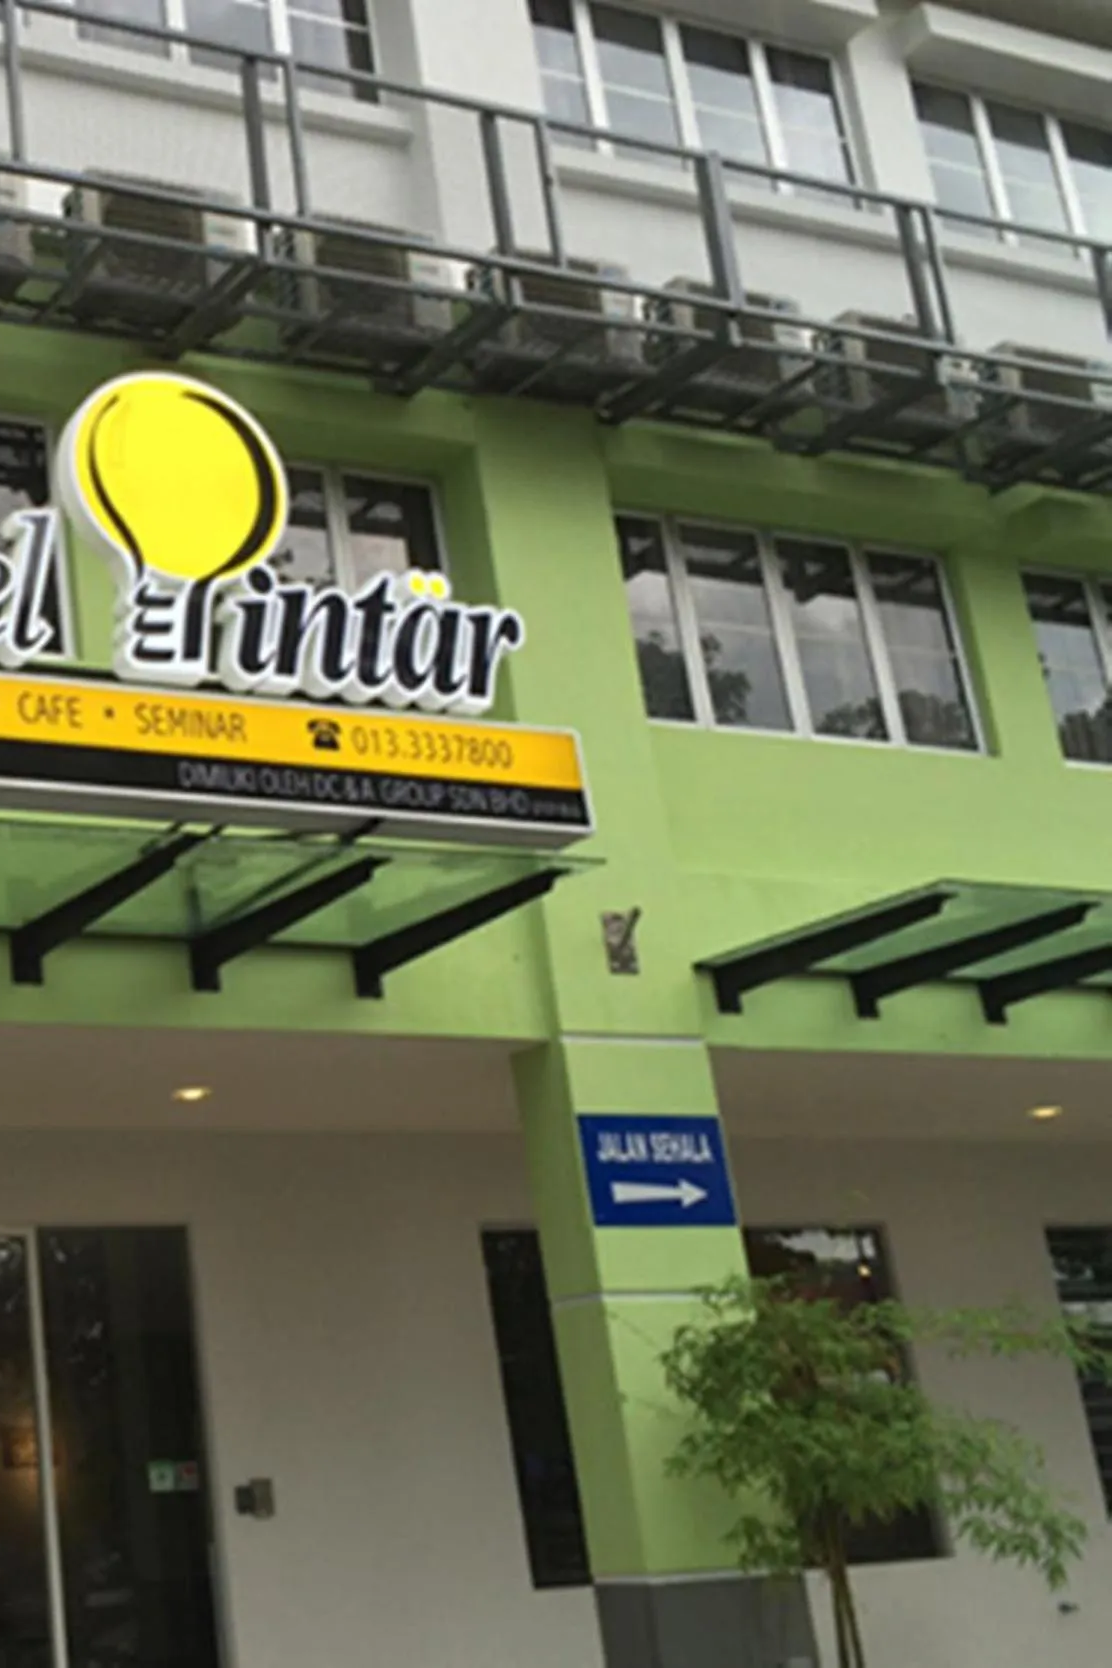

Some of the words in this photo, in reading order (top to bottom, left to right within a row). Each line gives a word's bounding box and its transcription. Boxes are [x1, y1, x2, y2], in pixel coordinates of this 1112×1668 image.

[17, 690, 83, 729] CAFE
[134, 701, 248, 743] SEMINAR
[350, 725, 514, 770] 013.3337800
[380, 778, 445, 807] GROUP
